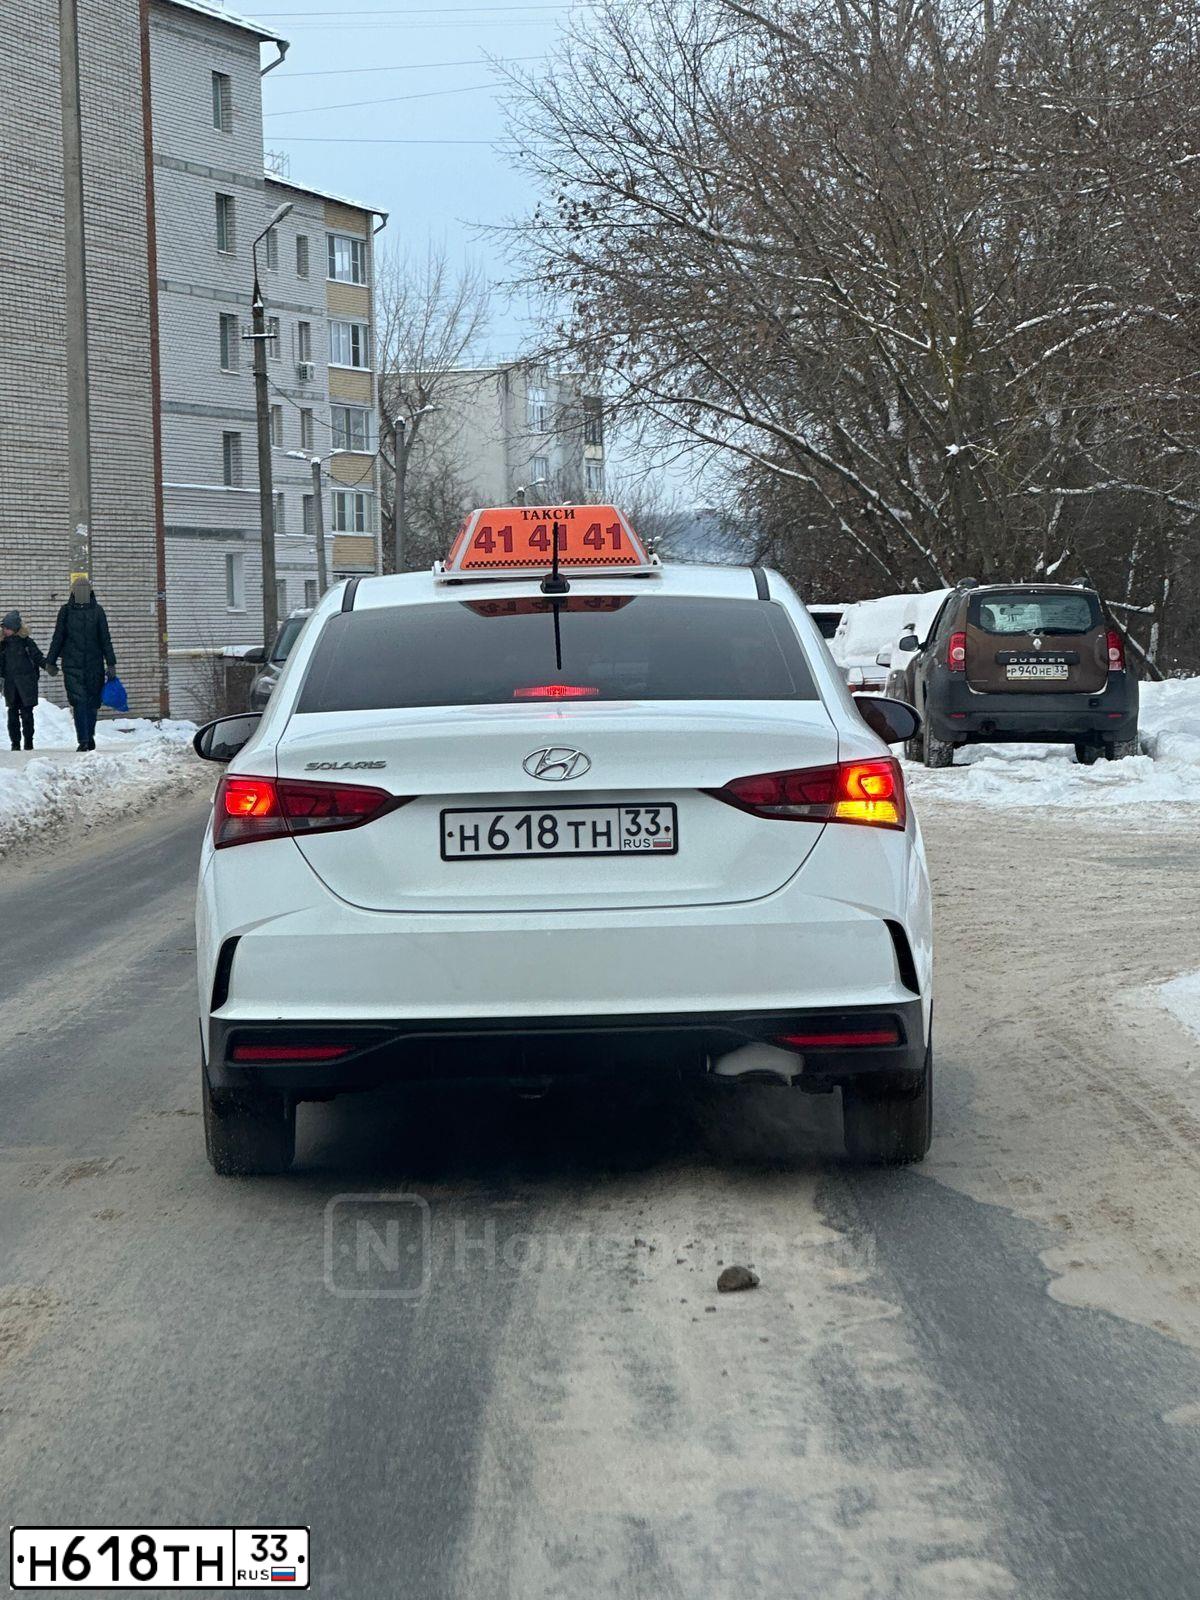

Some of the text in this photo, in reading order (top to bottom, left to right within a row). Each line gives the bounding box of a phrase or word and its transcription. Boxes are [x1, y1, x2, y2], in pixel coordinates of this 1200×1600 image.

[521, 509, 576, 521] ТАКСИ
[474, 522, 622, 554] 41 41 41
[304, 760, 387, 771] SOLARIS
[624, 809, 661, 837] 33
[623, 838, 652, 849] RUS
